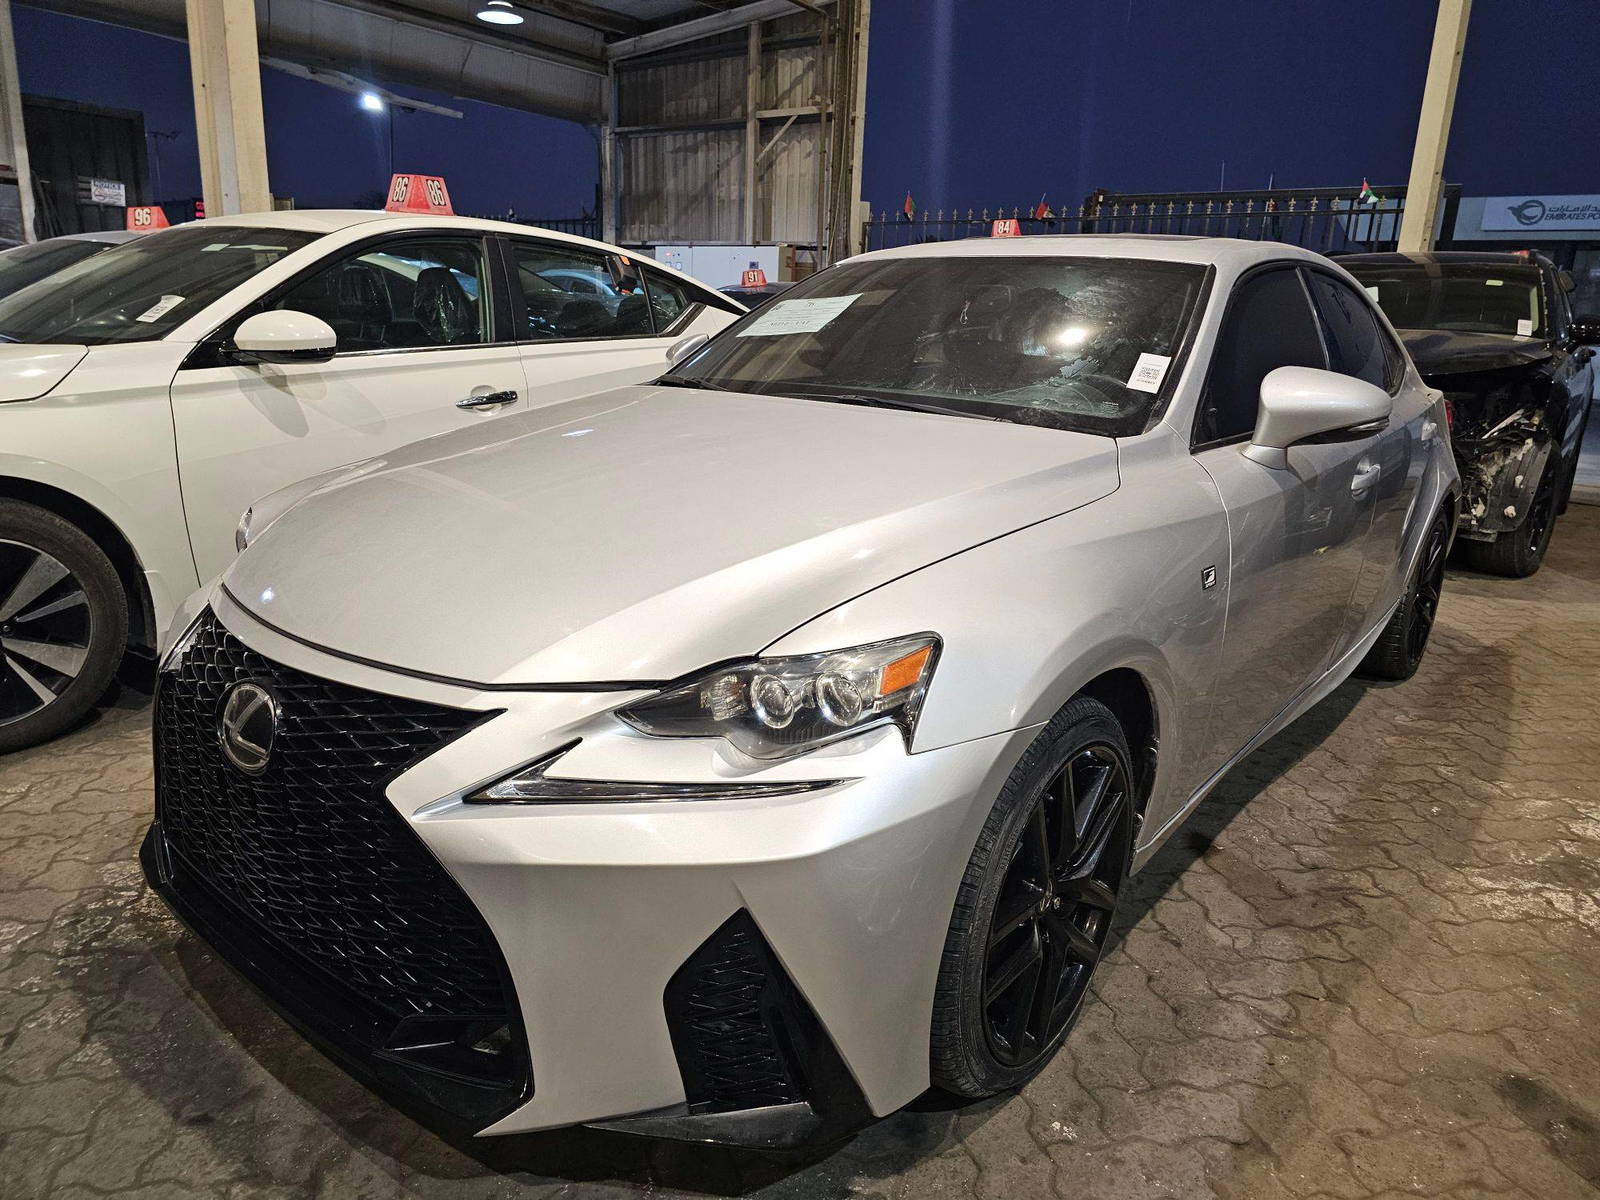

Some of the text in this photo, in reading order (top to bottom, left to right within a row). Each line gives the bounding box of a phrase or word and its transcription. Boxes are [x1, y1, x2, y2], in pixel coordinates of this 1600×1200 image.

[392, 176, 409, 202] 86
[426, 179, 446, 206] 86
[134, 207, 152, 226] 96
[1544, 212, 1586, 220] EMIRATES
[998, 221, 1010, 234] 84
[748, 271, 758, 282] 91
